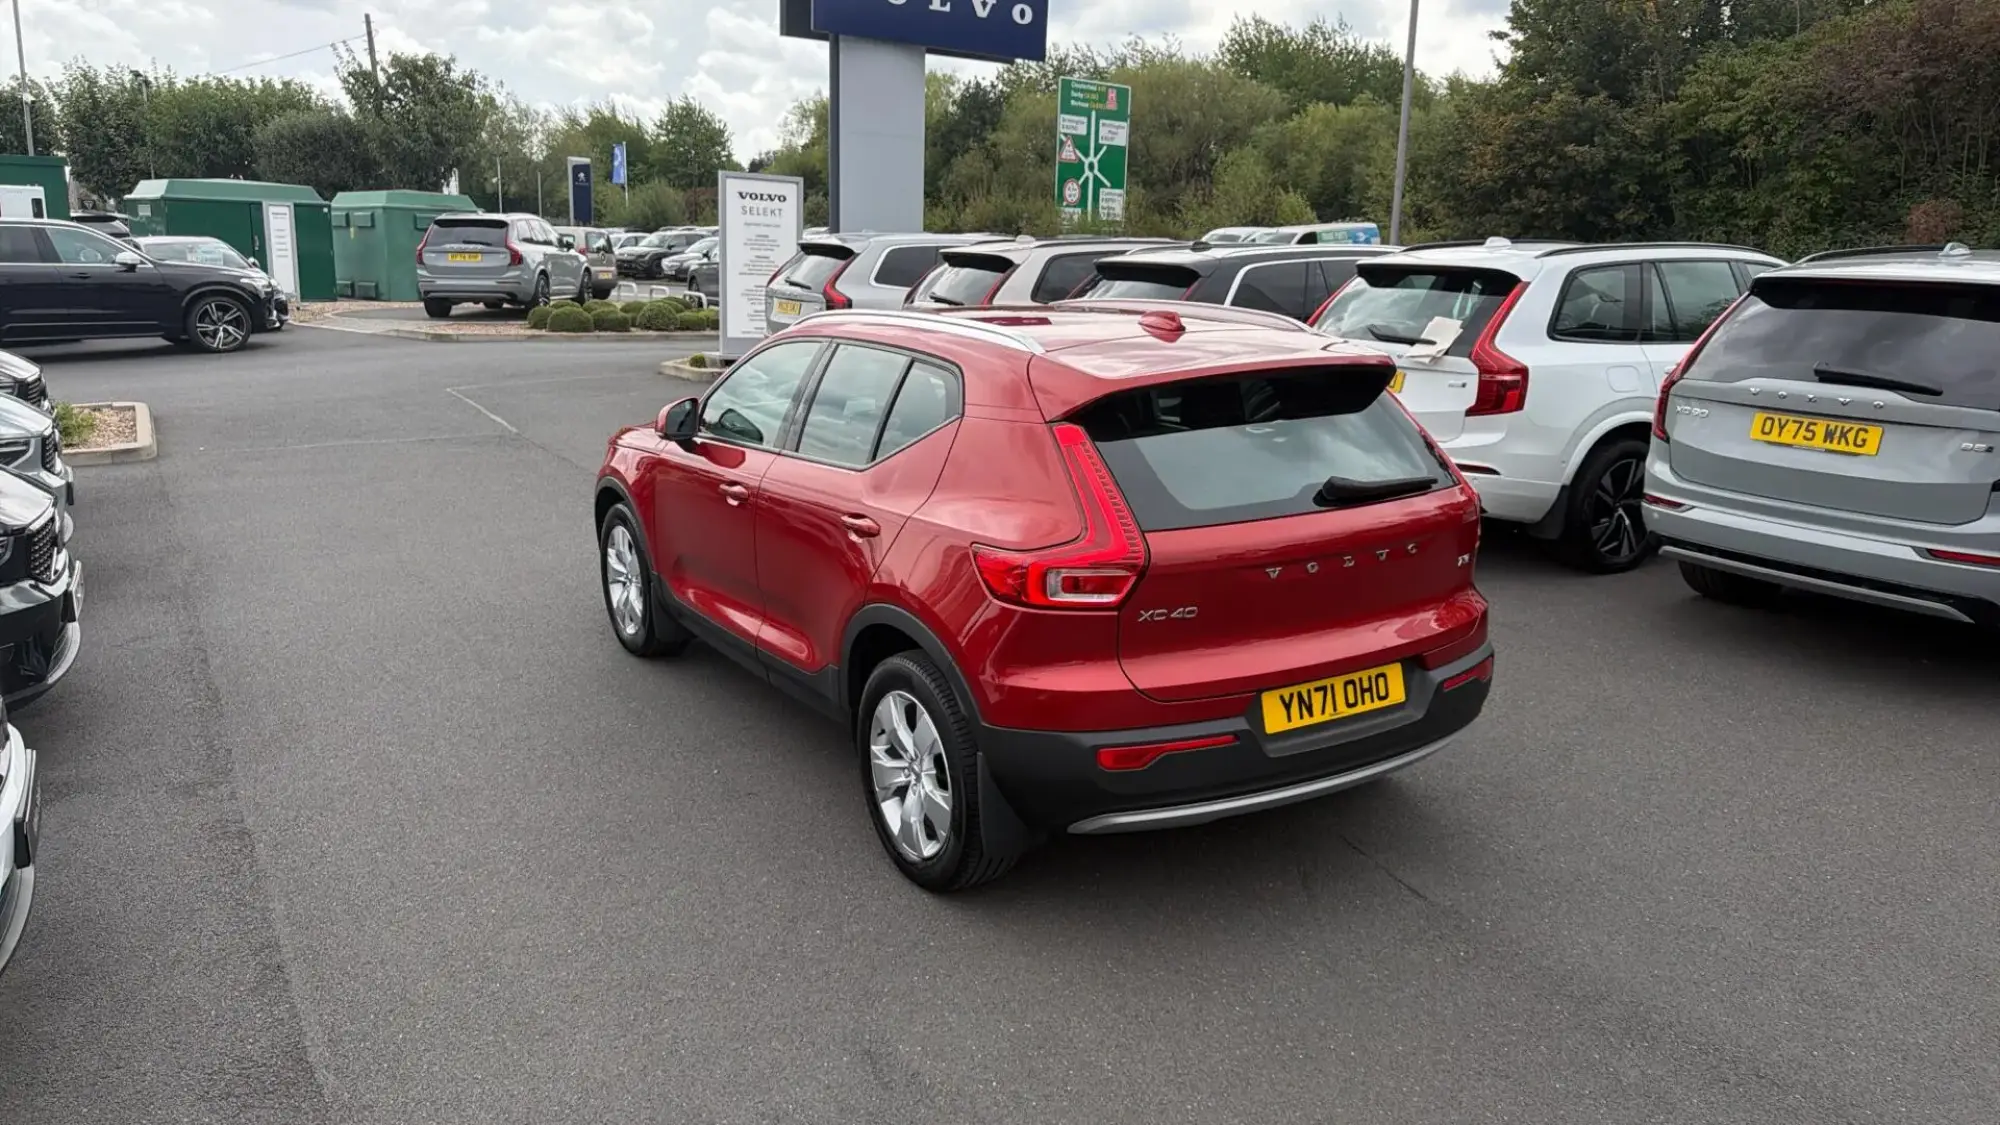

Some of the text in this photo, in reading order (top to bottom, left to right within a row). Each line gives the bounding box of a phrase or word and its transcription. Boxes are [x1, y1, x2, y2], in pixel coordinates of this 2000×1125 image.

[737, 191, 787, 203] VOLVO
[741, 205, 783, 217] SELEKT
[1750, 387, 1884, 409] VOLVO
[1760, 416, 1869, 448] OY75 WKG
[1279, 672, 1390, 723] YN71 OHO
